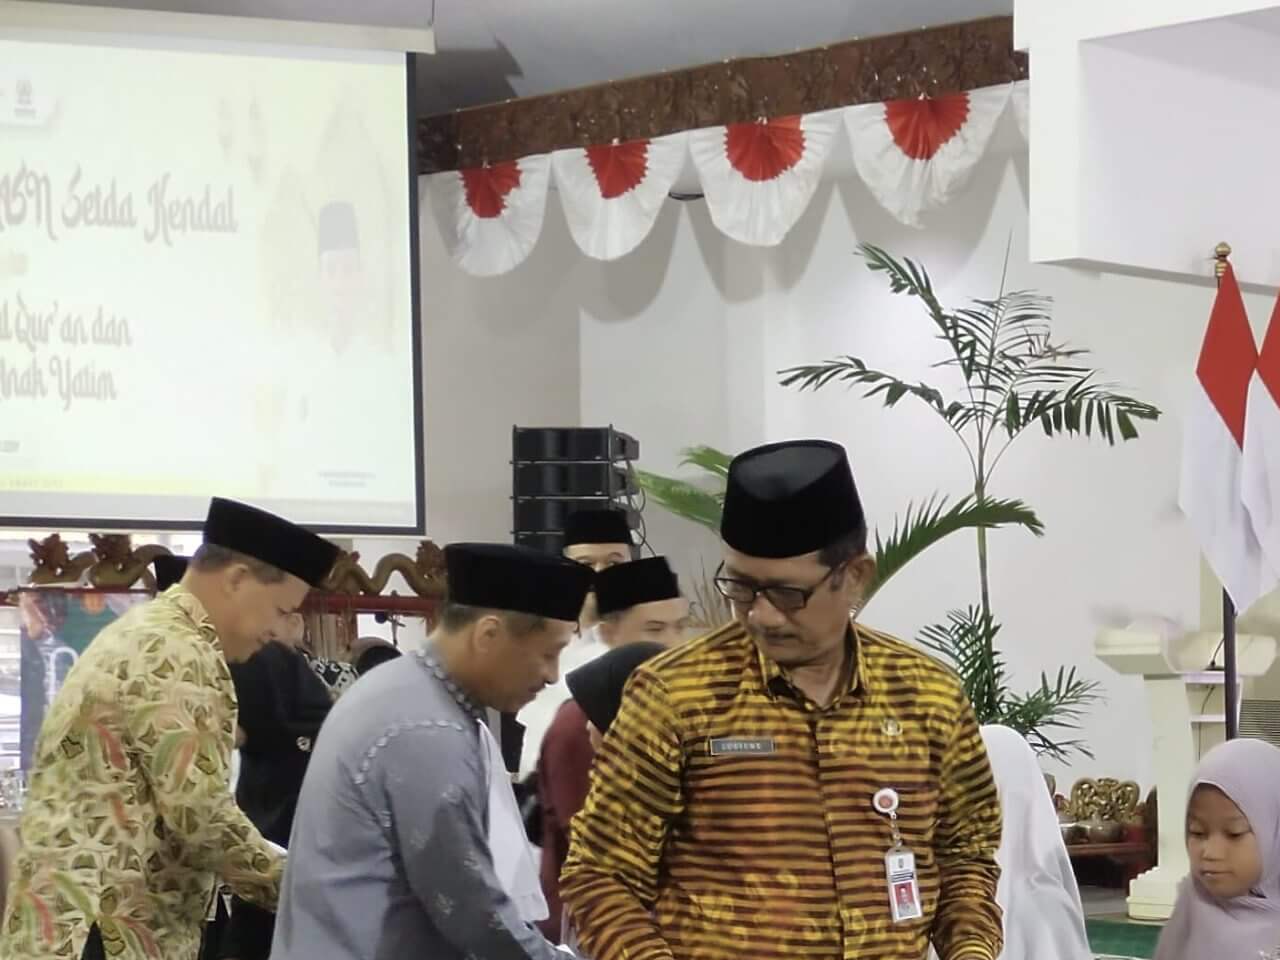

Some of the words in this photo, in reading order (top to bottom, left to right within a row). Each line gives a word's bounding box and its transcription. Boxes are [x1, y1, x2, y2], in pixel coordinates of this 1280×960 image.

[61, 163, 138, 228] Setda
[144, 170, 238, 247] Kendal
[91, 304, 133, 347] dan
[49, 355, 118, 411] Yatim
